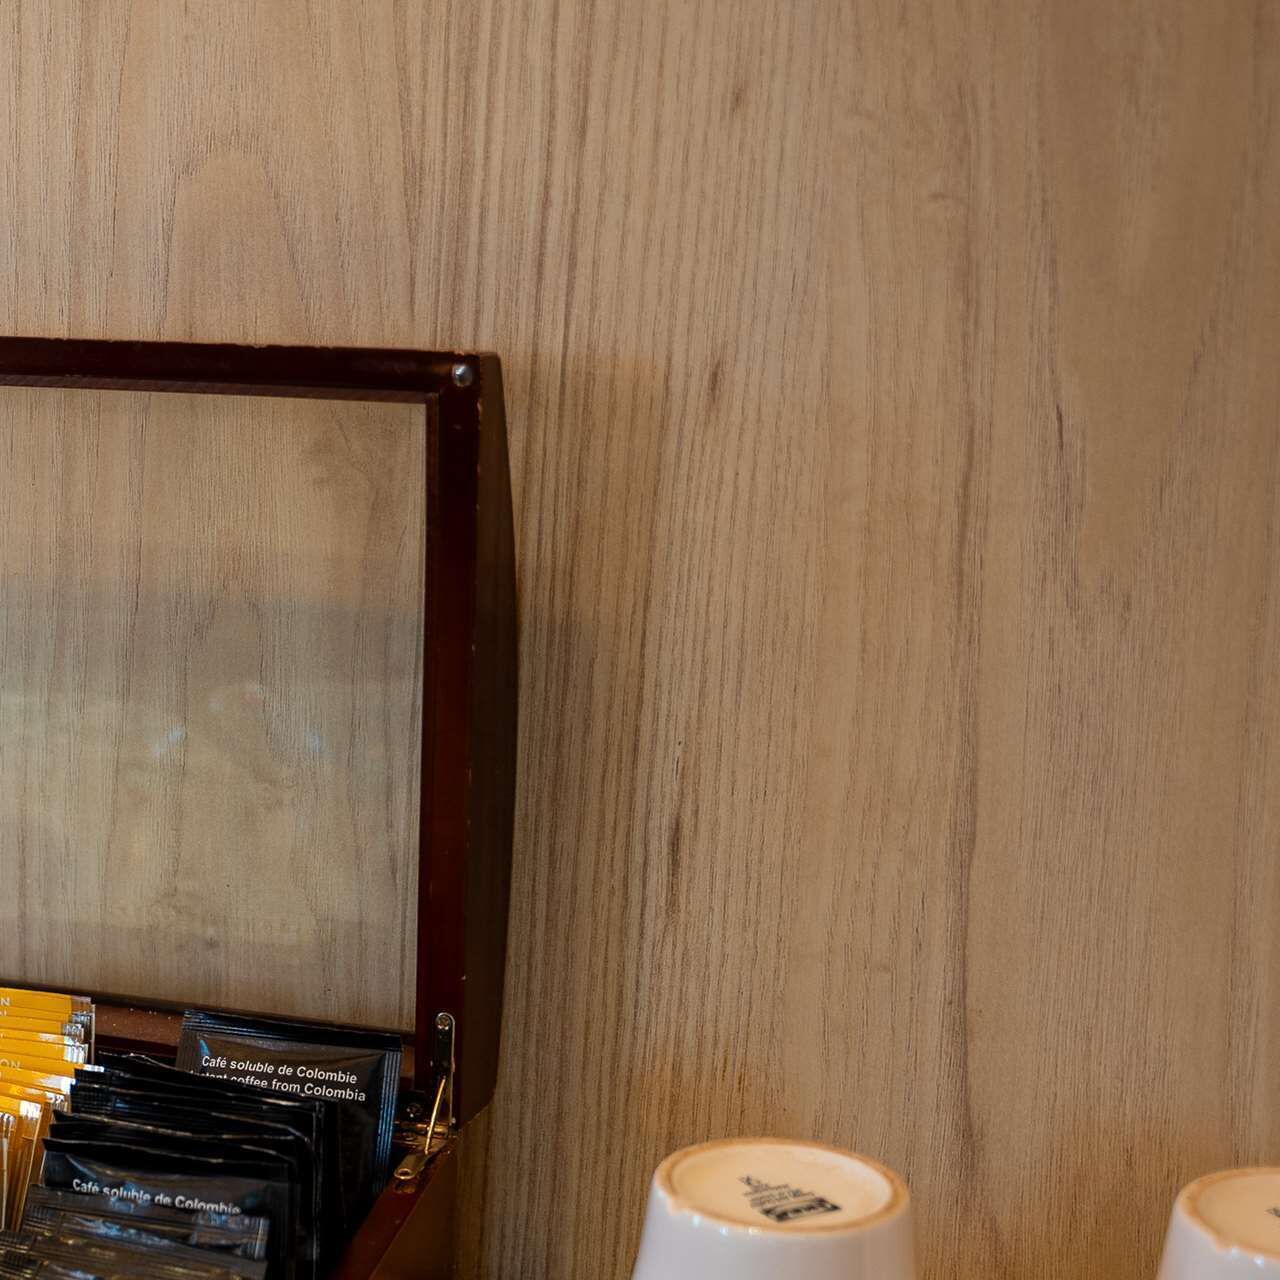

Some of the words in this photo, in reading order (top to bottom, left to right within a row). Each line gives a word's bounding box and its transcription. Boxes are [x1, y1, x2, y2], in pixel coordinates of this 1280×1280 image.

[202, 1055, 227, 1069] Café
[230, 1059, 275, 1074] soluble
[278, 1064, 294, 1076] de
[296, 1066, 358, 1084] Colombie
[271, 1078, 301, 1094] from
[304, 1082, 366, 1102] Colombia
